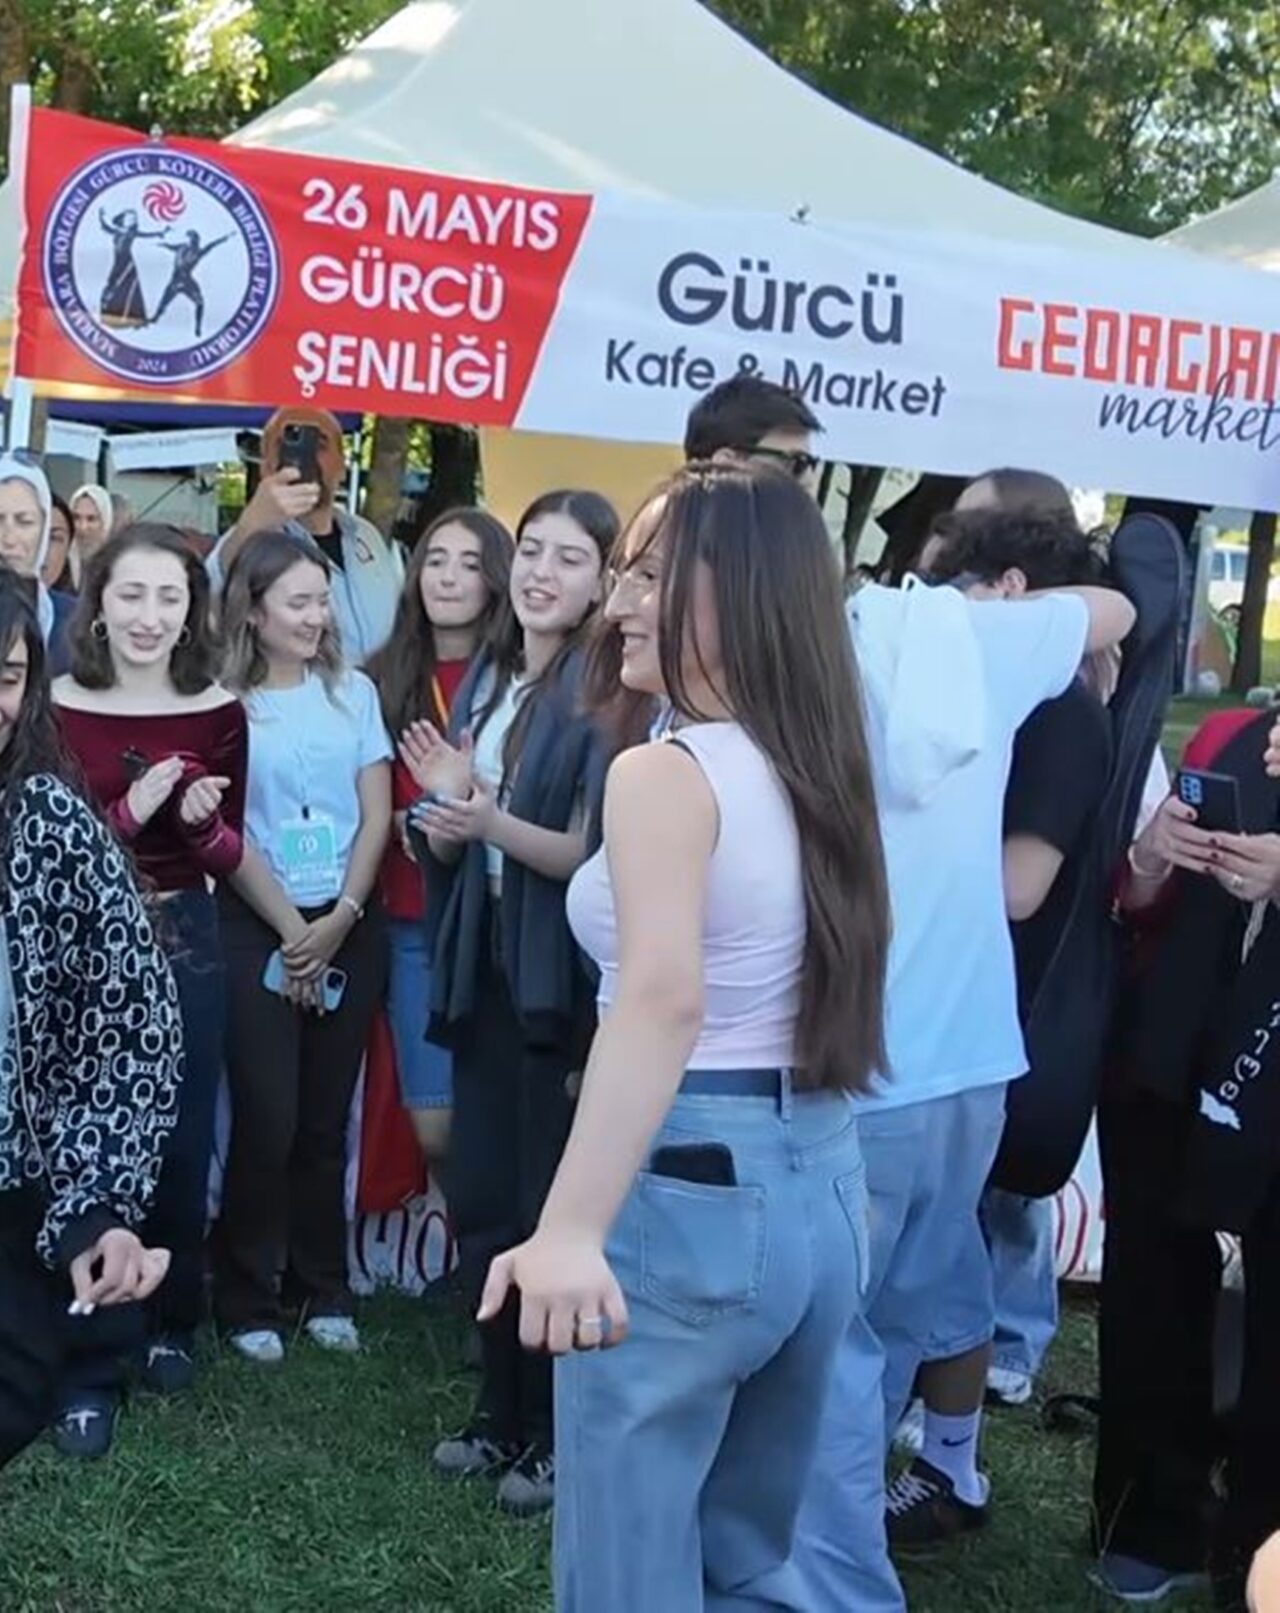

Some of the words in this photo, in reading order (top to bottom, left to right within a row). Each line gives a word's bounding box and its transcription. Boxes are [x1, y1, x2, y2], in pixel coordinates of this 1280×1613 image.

[90, 156, 151, 188] GÜRCÜ
[302, 178, 368, 230] 26
[386, 187, 560, 251] MAYIS
[300, 246, 504, 322] GÜRCÜ
[658, 251, 904, 345] Gürcü
[293, 331, 507, 402] ŞENLİĞİ
[605, 339, 715, 390] Kafe
[782, 358, 947, 417] Market
[1098, 369, 1280, 451] market
